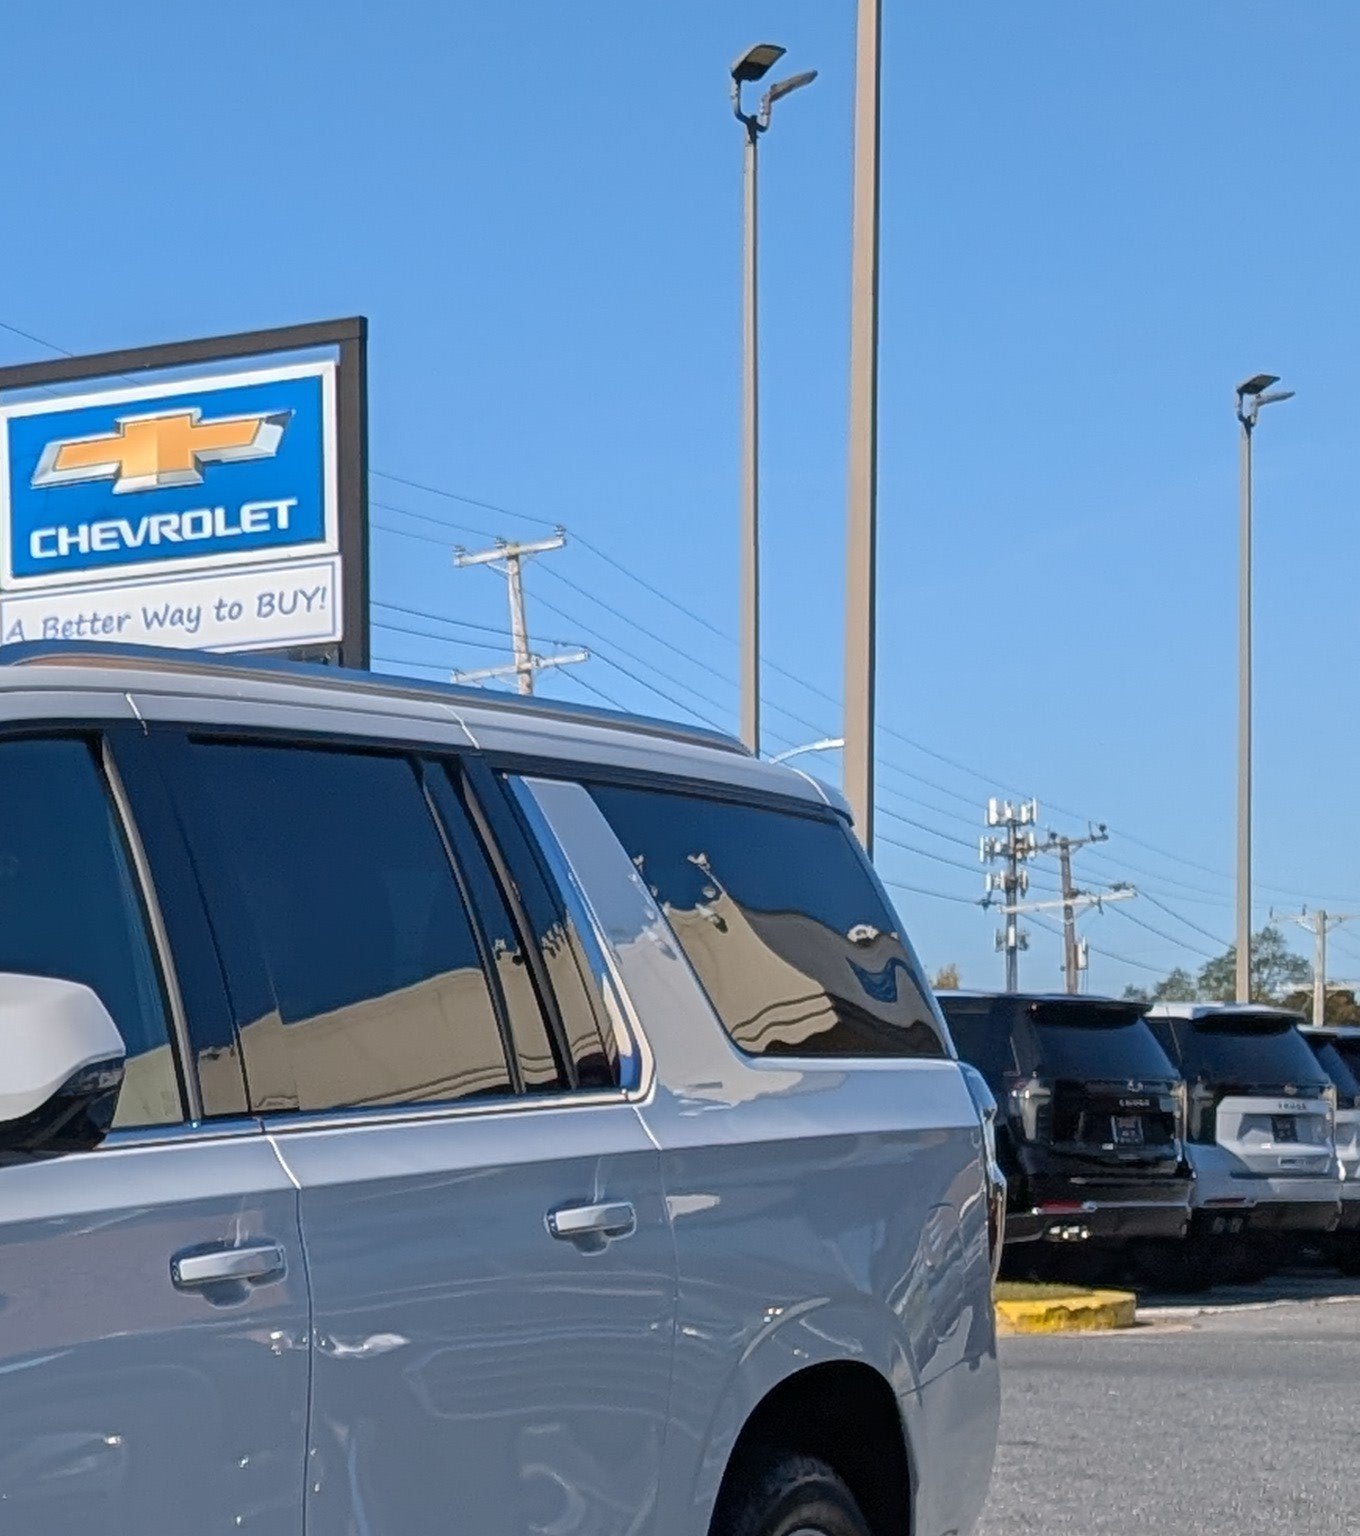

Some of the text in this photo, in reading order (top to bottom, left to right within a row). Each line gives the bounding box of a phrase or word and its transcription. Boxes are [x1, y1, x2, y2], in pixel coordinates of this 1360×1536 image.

[29, 498, 299, 560] CHEVROLET
[5, 586, 327, 641] A Better Way to BUY!
